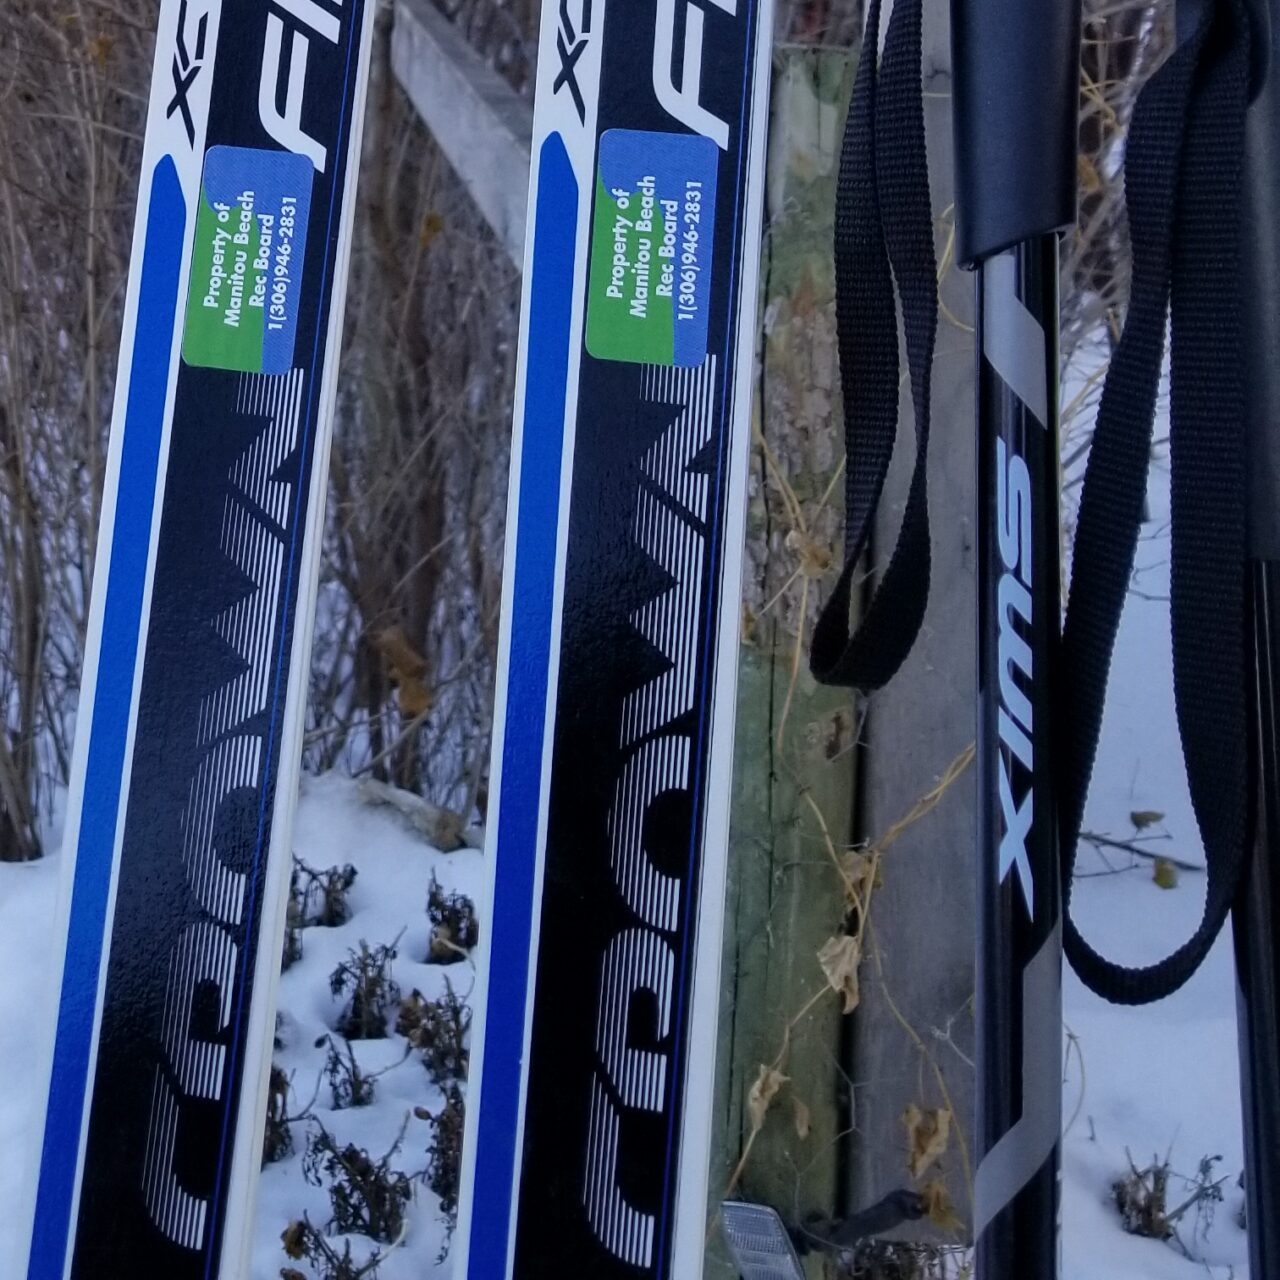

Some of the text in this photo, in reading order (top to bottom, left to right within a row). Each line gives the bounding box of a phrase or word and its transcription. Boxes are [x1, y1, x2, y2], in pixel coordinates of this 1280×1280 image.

[203, 202, 232, 309] Property of
[223, 190, 255, 328] Manitou Beach
[248, 214, 275, 308] Rec Board
[268, 197, 297, 330] 1(306)946-2831
[606, 188, 633, 299] Property of
[629, 175, 656, 318] Manitou Beach
[655, 199, 679, 297] Rec Board
[677, 181, 703, 321] 1(306)946-2831
